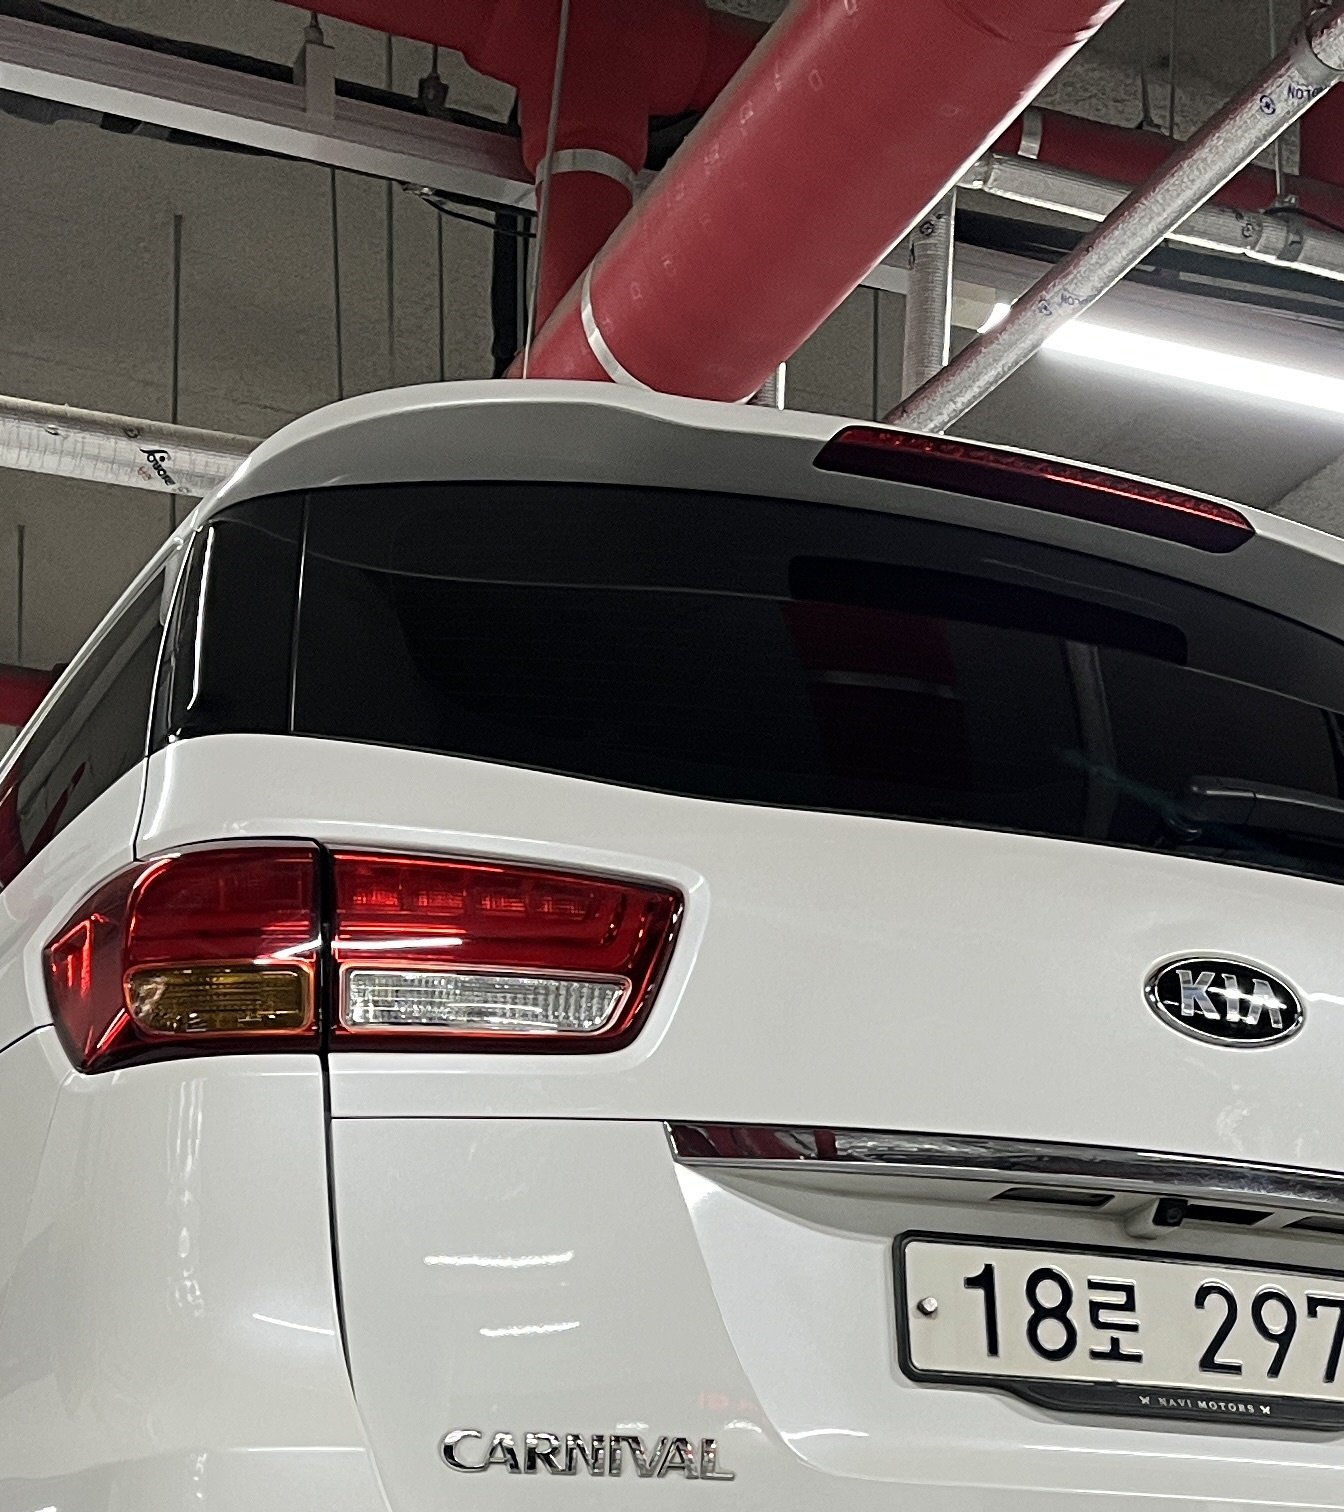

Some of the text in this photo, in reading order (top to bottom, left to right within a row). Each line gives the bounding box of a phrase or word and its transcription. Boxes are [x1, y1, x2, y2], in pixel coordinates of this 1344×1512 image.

[1175, 969, 1284, 1030] KIA
[963, 1263, 1144, 1362] 18로
[1157, 1396, 1255, 1414] NAVI MOTORS
[439, 1429, 736, 1481] CARNIVAL
